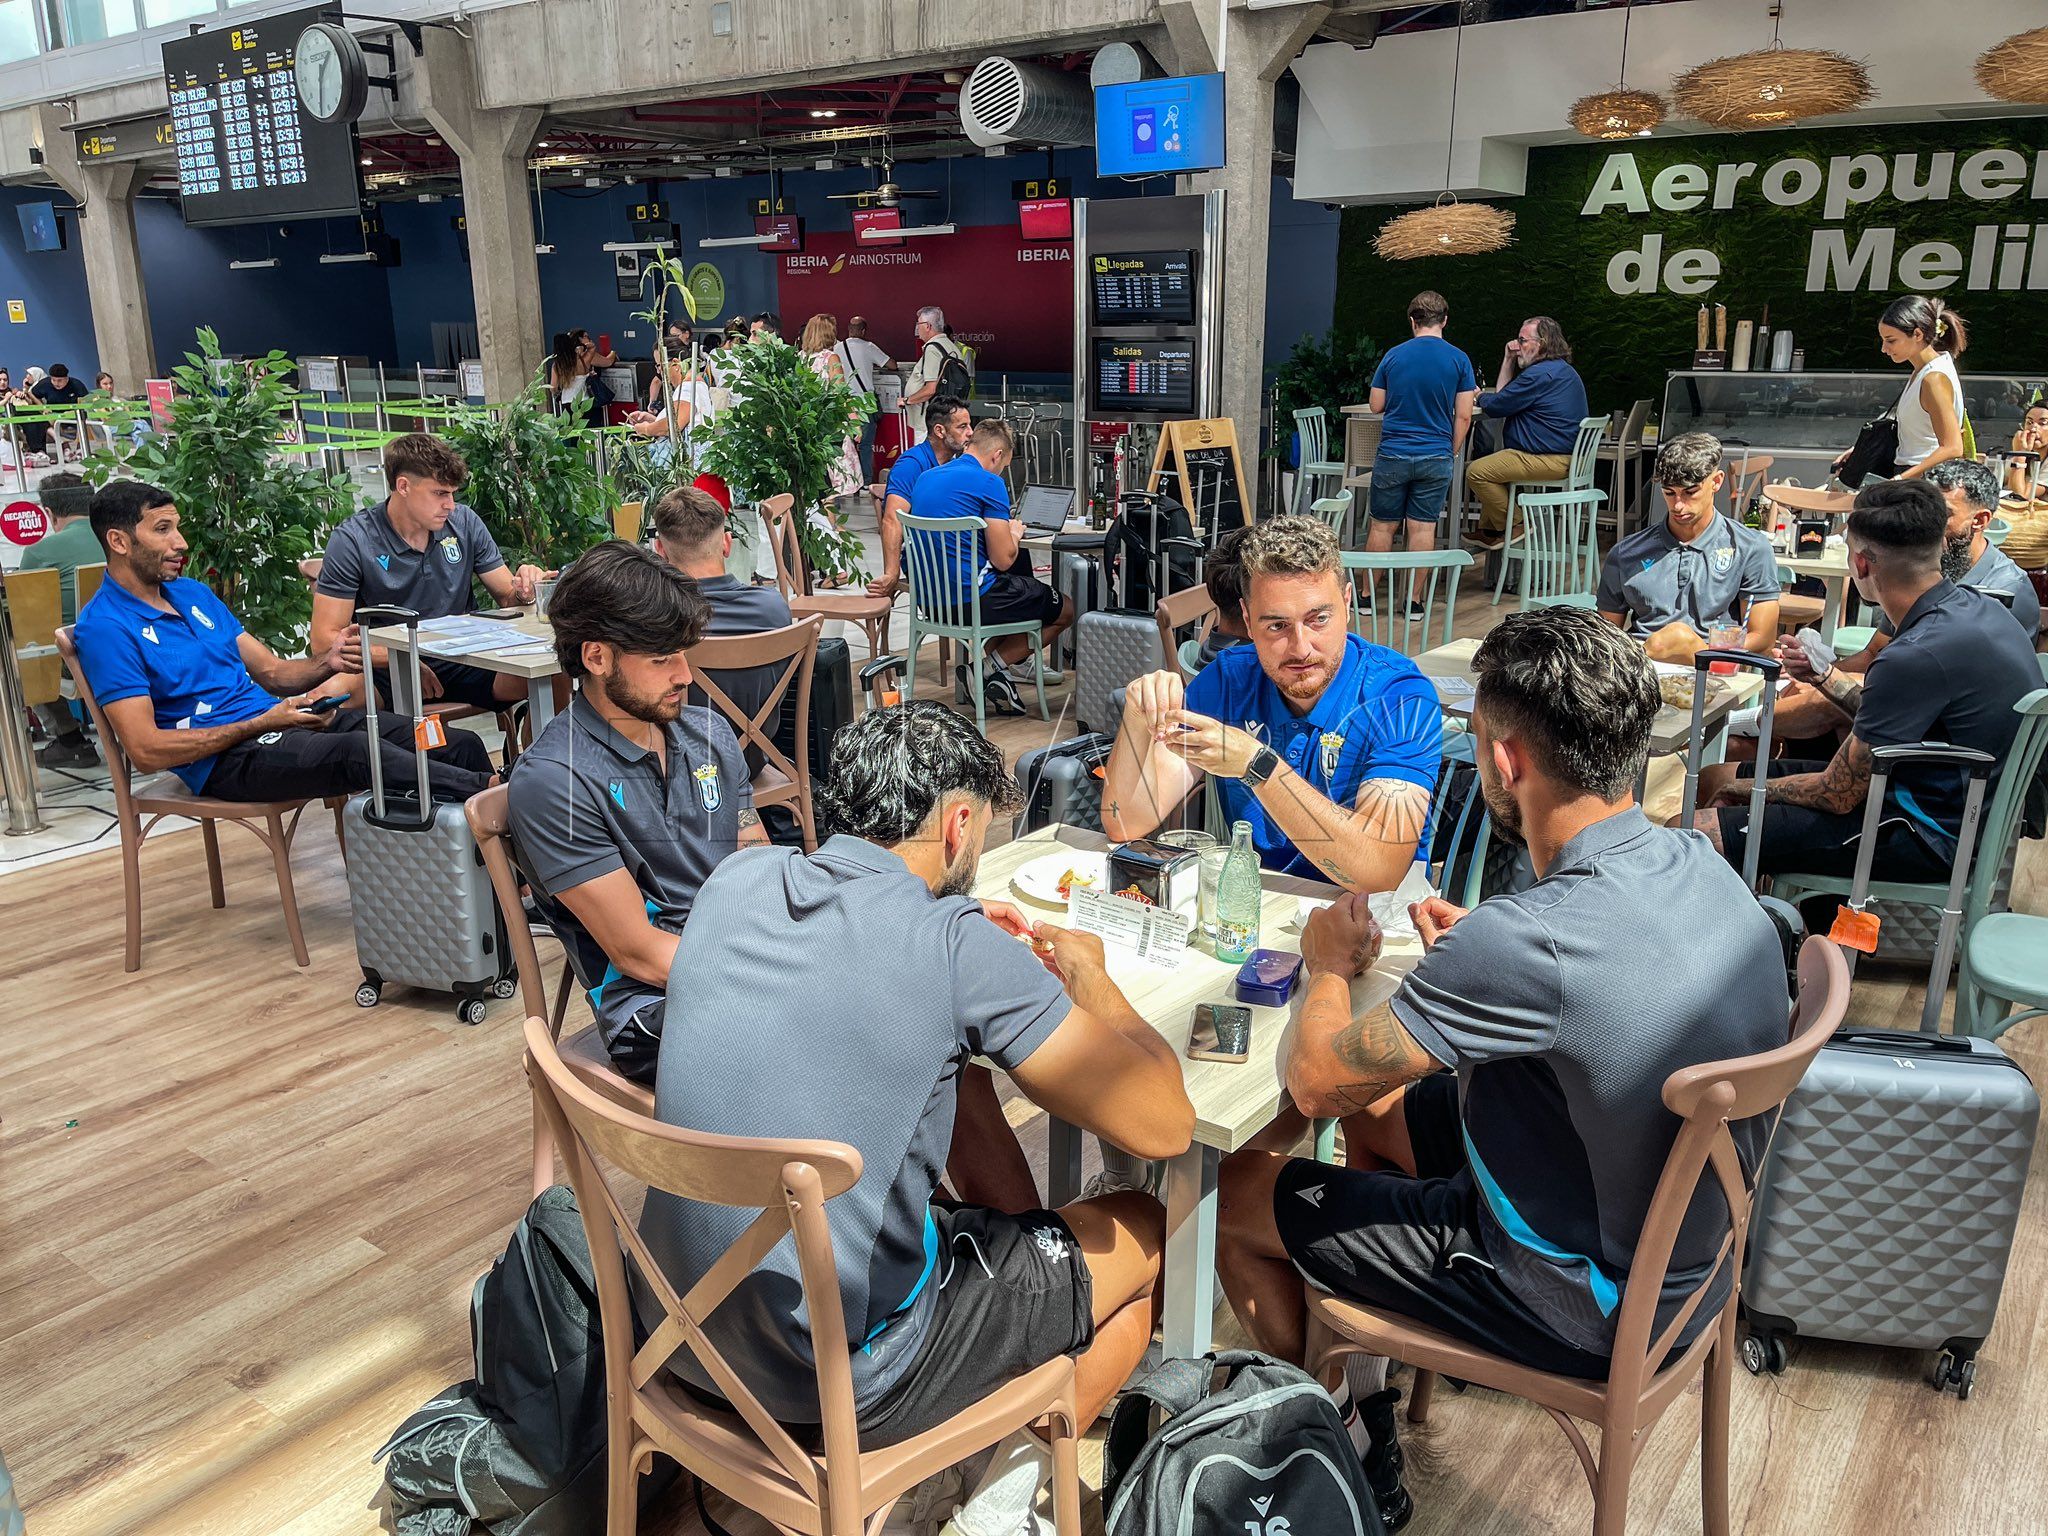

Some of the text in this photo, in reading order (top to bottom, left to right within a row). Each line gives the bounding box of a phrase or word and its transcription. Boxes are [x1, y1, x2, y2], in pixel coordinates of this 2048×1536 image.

[289, 70, 293, 82] 1
[290, 85, 295, 96] 3
[292, 99, 298, 110] 2
[294, 114, 299, 125] 1
[295, 128, 301, 139] 2
[298, 142, 302, 154] 1
[299, 156, 304, 168] 2
[301, 171, 306, 182] 3
[1047, 179, 1057, 197] 6
[652, 204, 660, 218] 3
[776, 198, 785, 213] 4
[787, 253, 922, 267] IBERIA AIRNOSTRUM
[1017, 249, 1070, 262] IBERIA
[1108, 260, 1144, 270] Llegadas
[1606, 233, 1720, 295] de
[952, 330, 994, 342] acturación
[1113, 347, 1142, 356] Salidas
[4, 510, 37, 521] RECARGA
[19, 514, 42, 530] AQUÍ
[1244, 1515, 1293, 1536] 16
